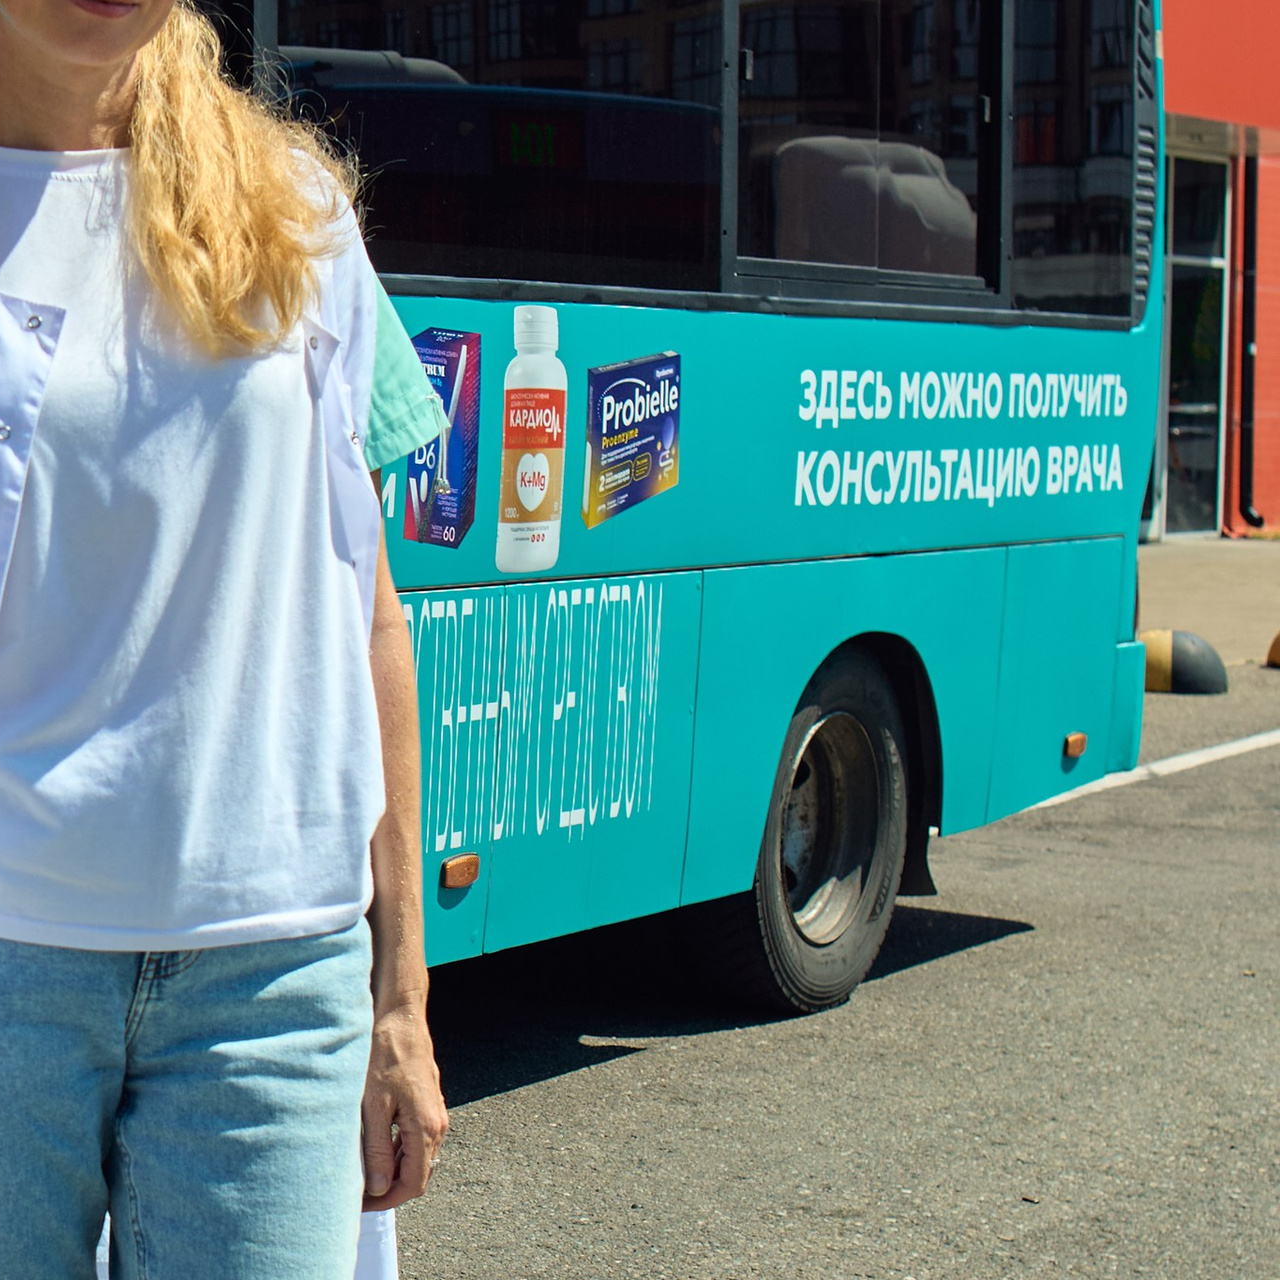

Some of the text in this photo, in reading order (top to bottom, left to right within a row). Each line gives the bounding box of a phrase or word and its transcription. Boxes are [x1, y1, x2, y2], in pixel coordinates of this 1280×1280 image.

[602, 378, 679, 434] Probielle
[799, 369, 1128, 428] ЗДЕСЬ МОЖНО ПОЛУЧИТЬ
[795, 444, 1123, 507] КОНСУЛЬТАЦИЮ ВРАЧА
[443, 525, 456, 543] 60
